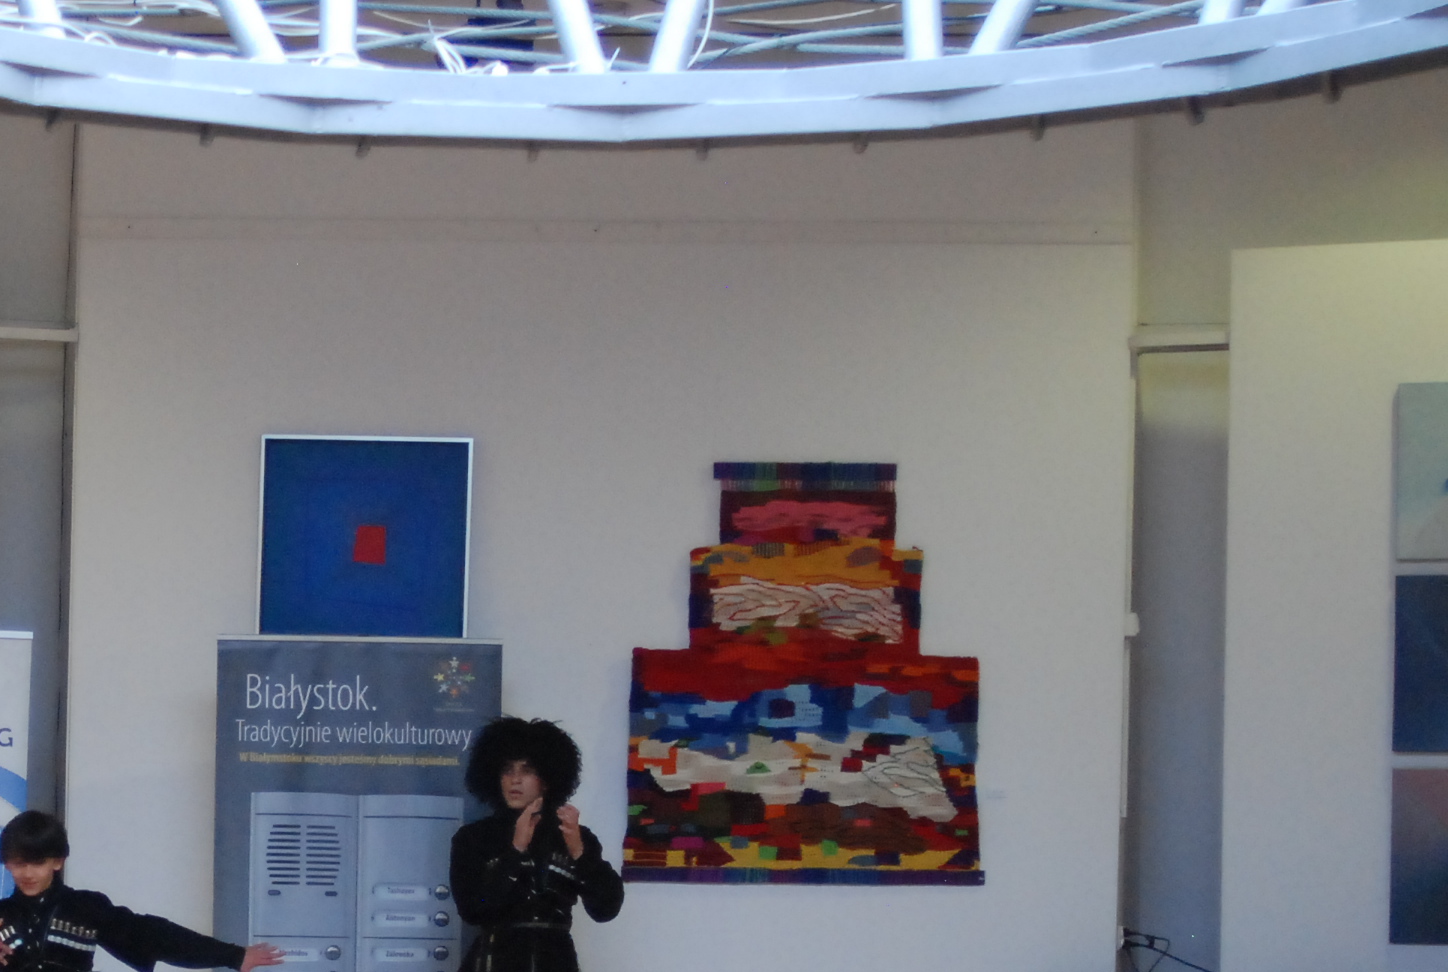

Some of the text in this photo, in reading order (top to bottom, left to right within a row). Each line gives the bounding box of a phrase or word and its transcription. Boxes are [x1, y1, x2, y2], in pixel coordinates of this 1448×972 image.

[246, 673, 377, 720] Białystok.
[236, 718, 473, 751] Tradycyjnie wielokulturowy
